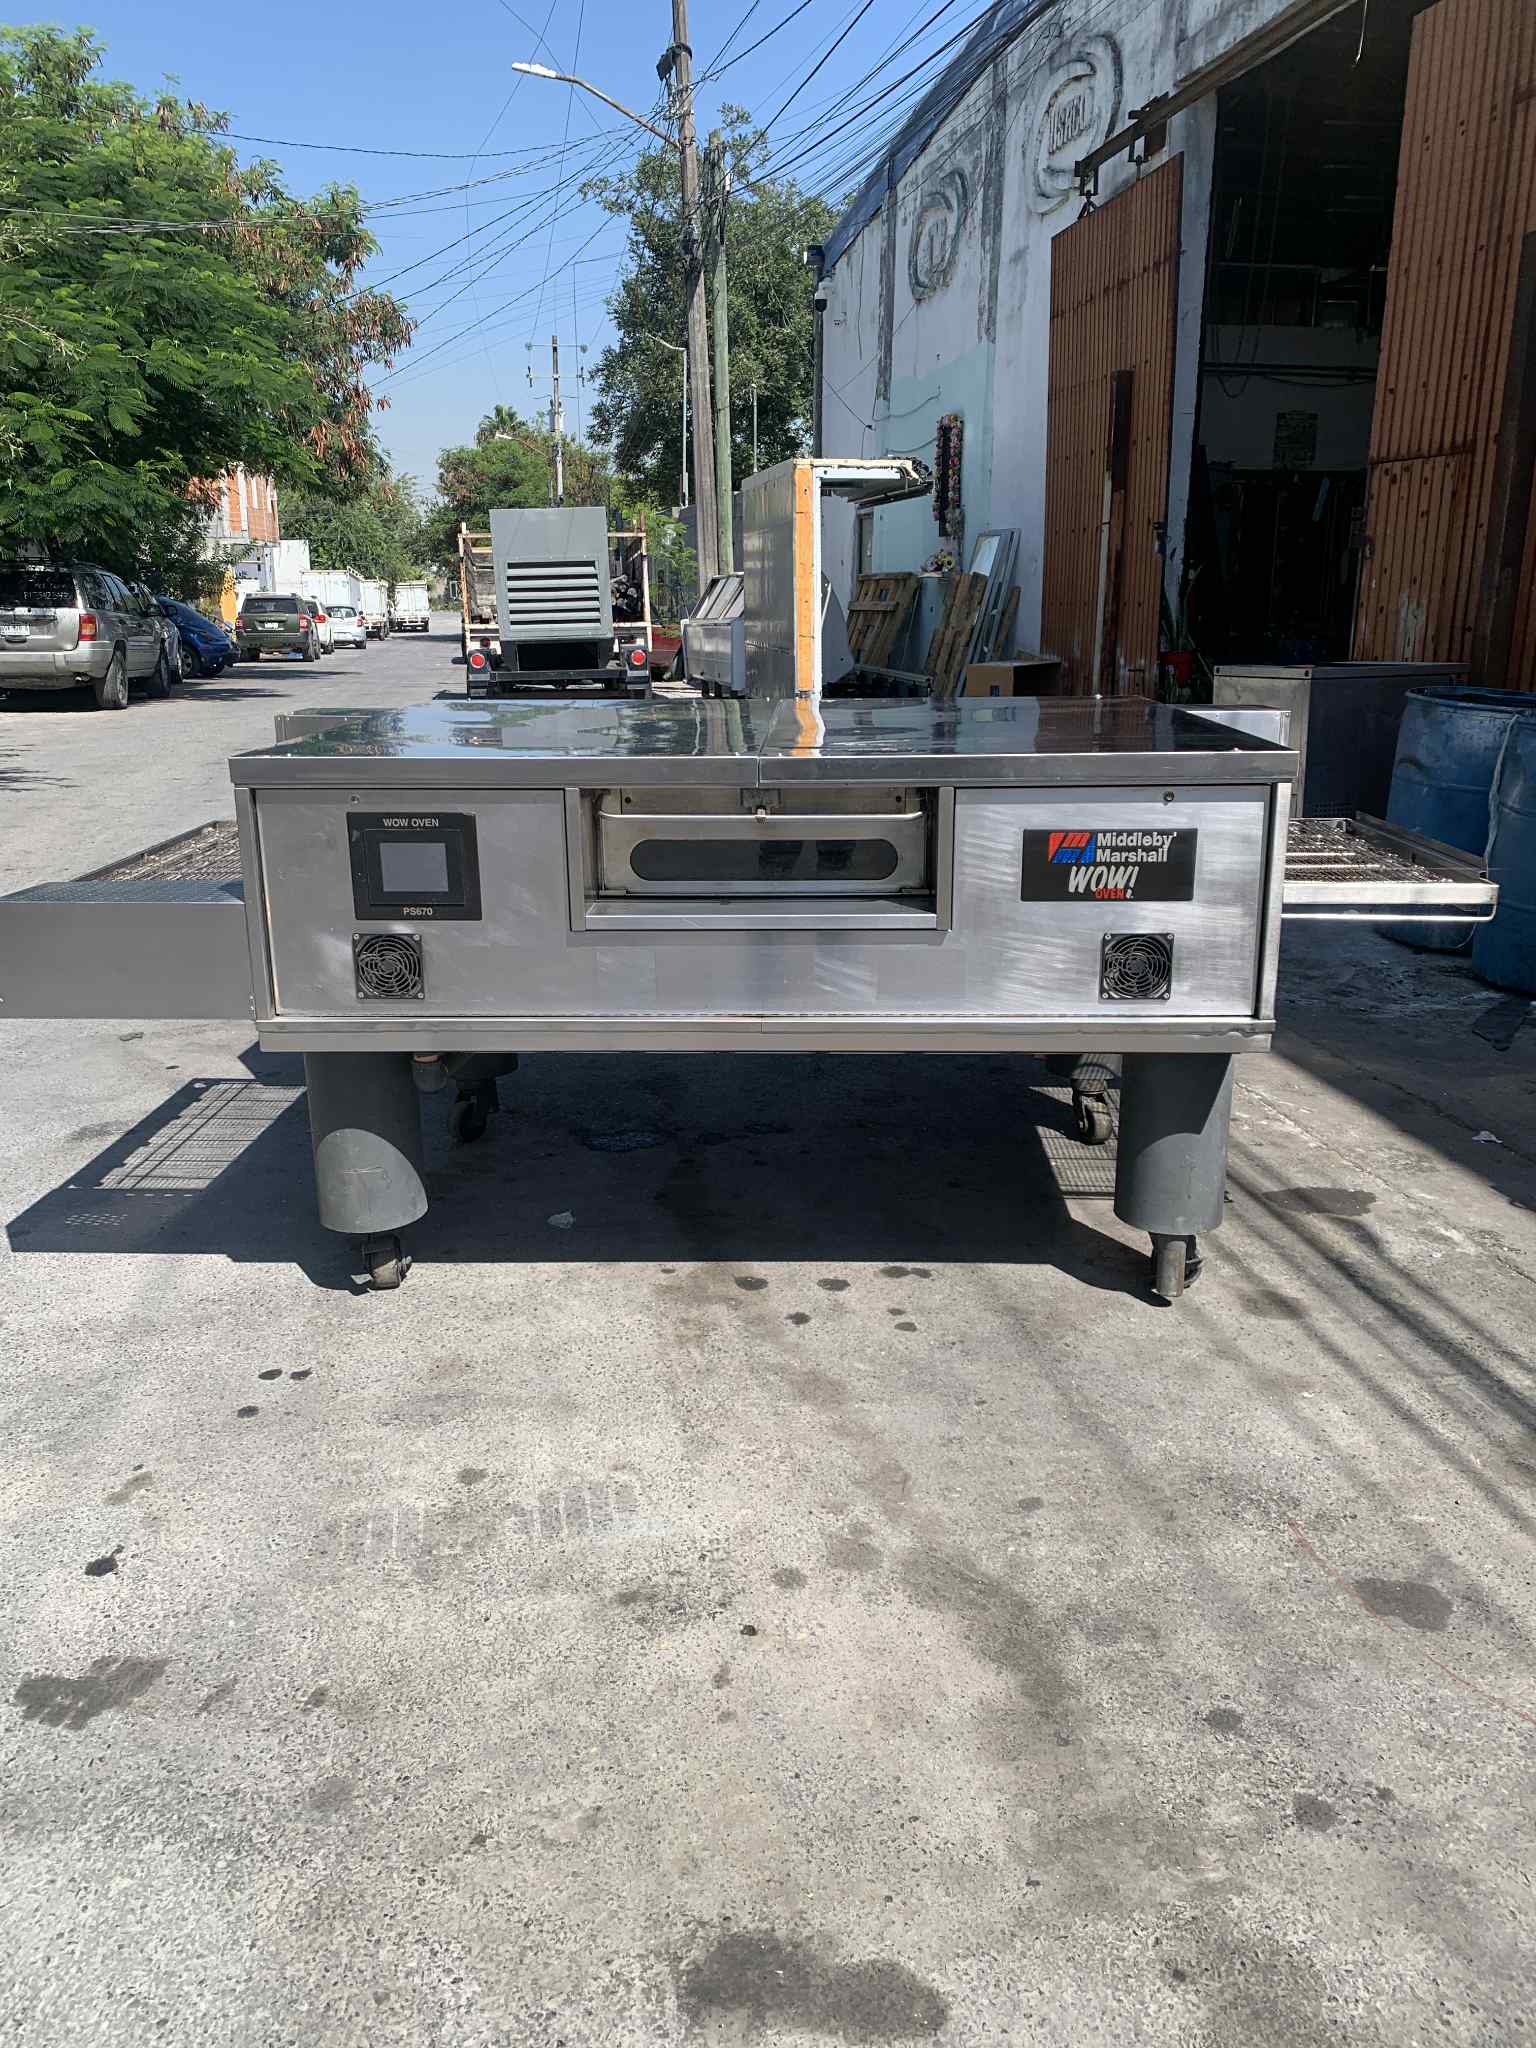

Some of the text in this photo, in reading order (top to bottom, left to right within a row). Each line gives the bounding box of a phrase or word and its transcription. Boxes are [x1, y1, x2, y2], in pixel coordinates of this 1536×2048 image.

[383, 818, 439, 827] WOW OVEN
[1096, 831, 1174, 849] Middleby
[1095, 848, 1169, 862] Marshall
[1068, 865, 1138, 899] WOW!
[1095, 888, 1125, 899] OVEN
[403, 907, 433, 916] PS670
